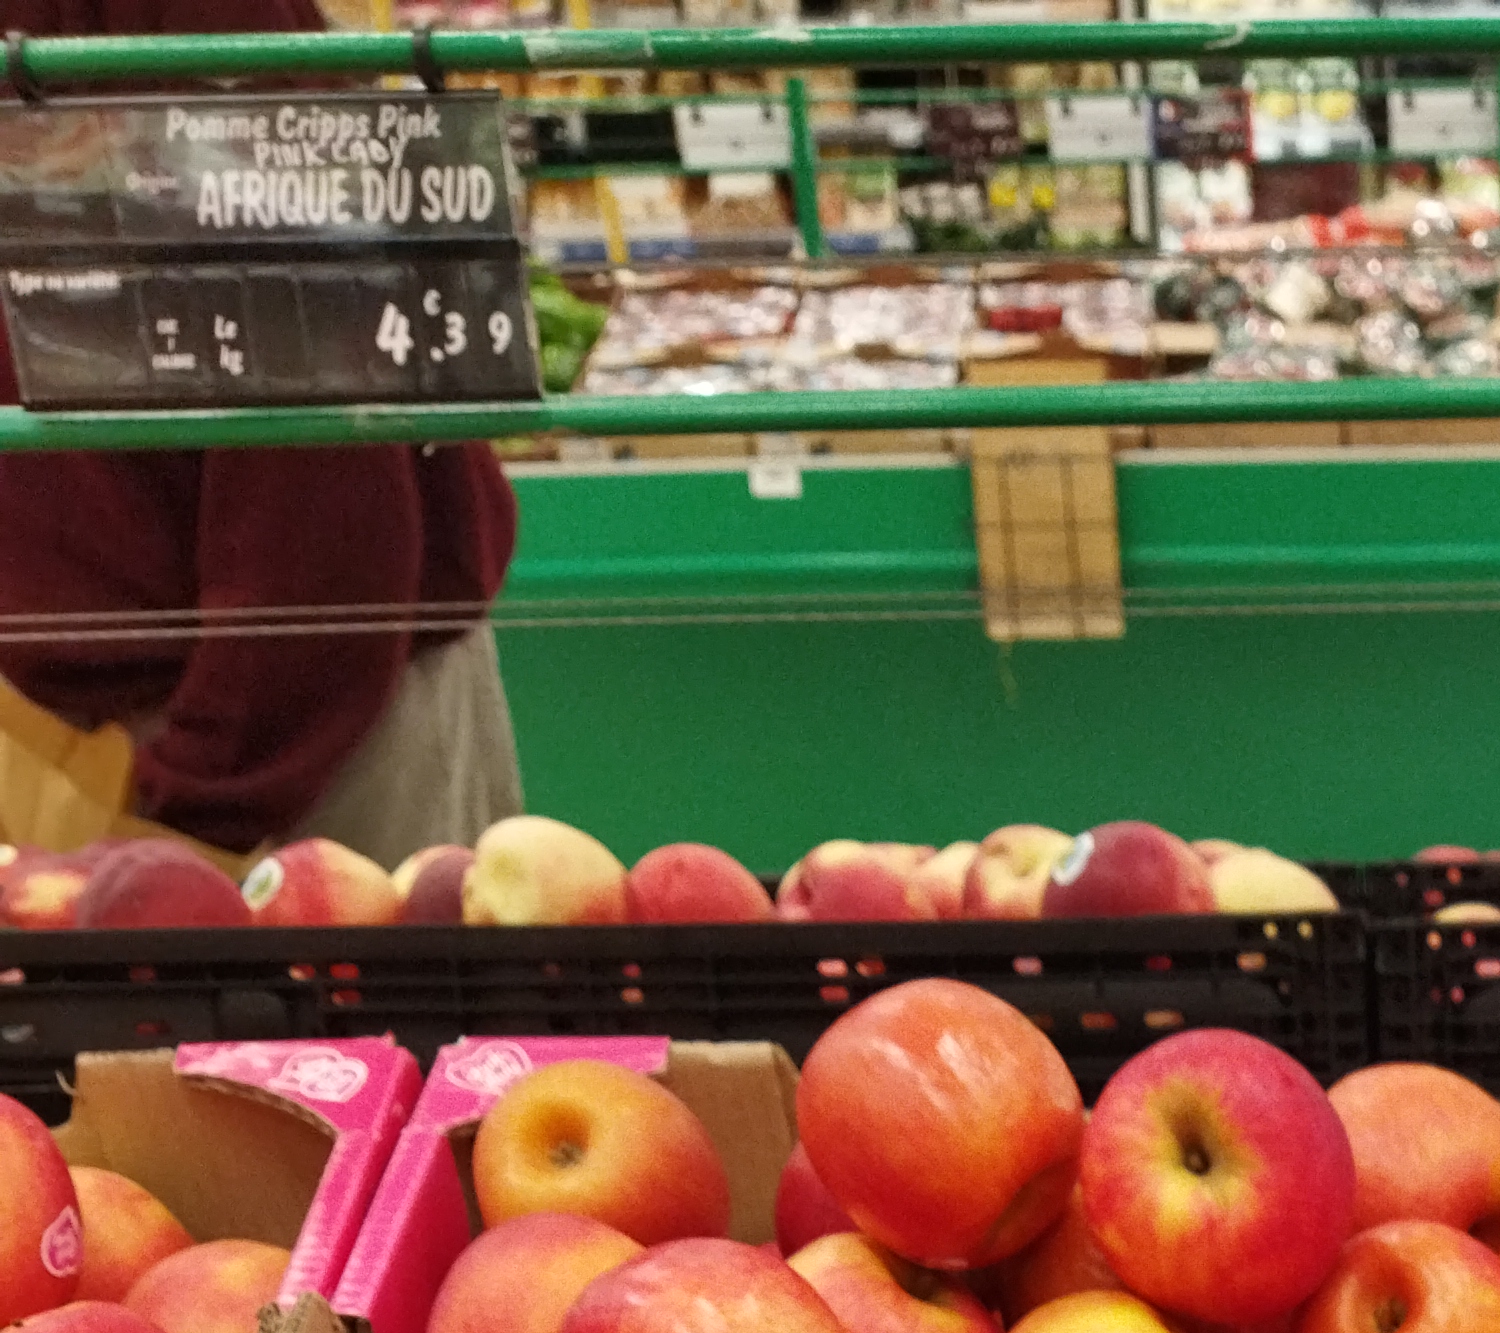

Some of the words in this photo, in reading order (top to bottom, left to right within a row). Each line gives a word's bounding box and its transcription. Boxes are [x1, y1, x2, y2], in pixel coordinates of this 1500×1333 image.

[165, 106, 270, 142] Pomme
[276, 104, 370, 148] Cripps
[377, 103, 442, 139] Pink
[196, 167, 354, 229] AFRIQUE
[360, 166, 413, 224] DU
[420, 163, 496, 223] SUD
